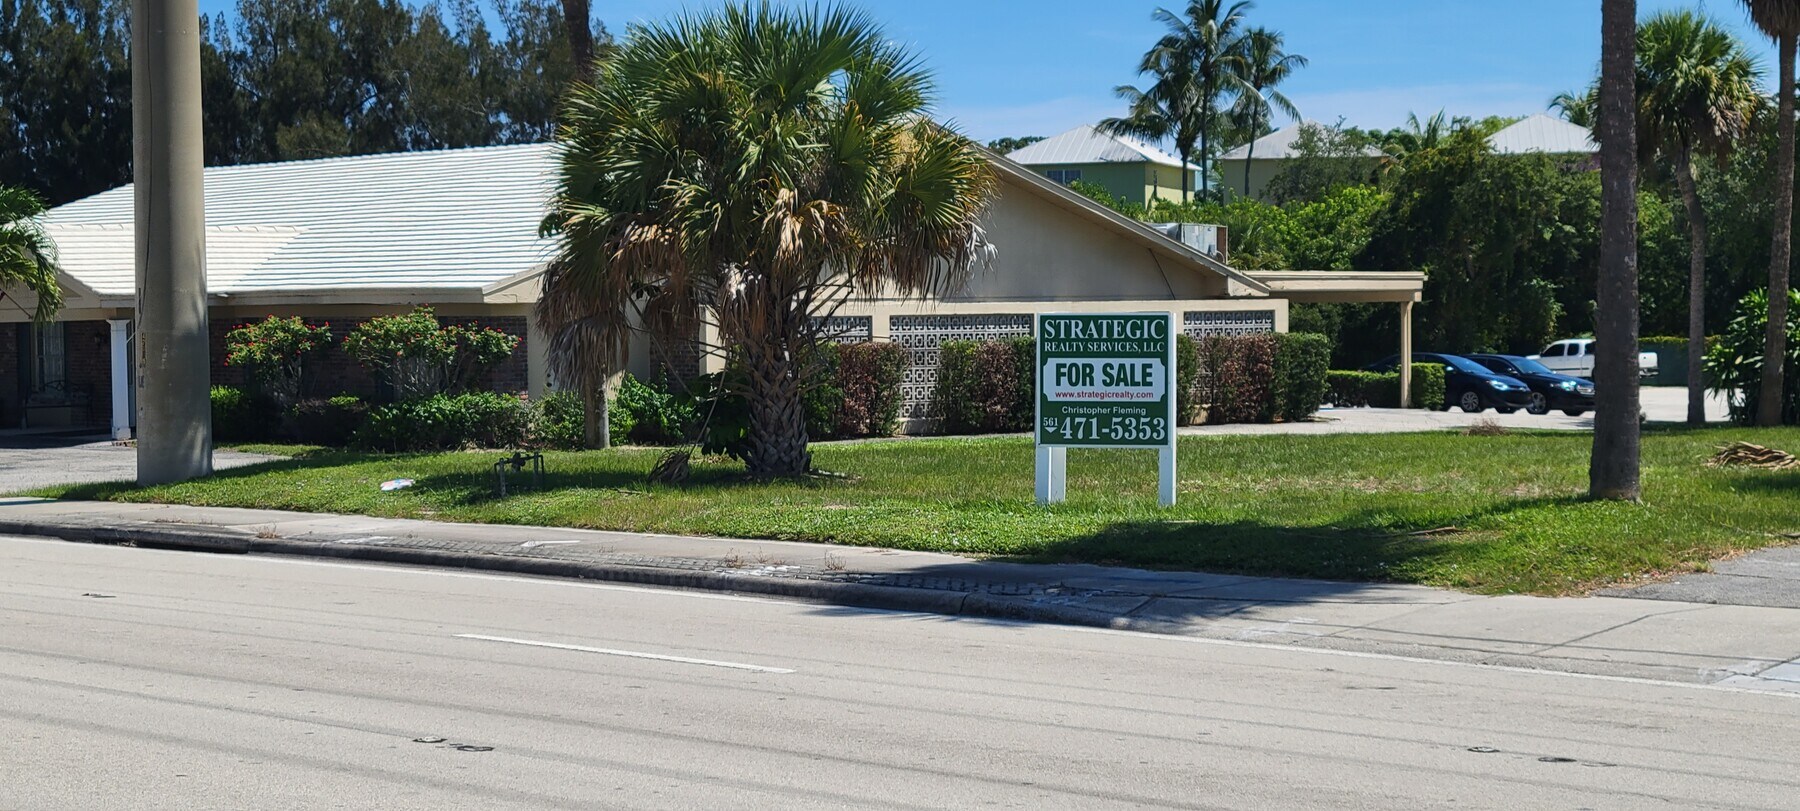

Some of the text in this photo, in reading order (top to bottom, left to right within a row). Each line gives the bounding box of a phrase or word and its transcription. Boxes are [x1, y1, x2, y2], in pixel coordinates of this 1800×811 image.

[1045, 319, 1165, 339] STRATEGIC
[1045, 342, 1165, 354] REALTY SERVICES, LLC
[1056, 363, 1153, 387] FOR SALE
[1055, 390, 1154, 400] www.strategicrealty.com
[1062, 406, 1146, 415] Christopher Fleming
[1043, 417, 1165, 440] 561 471-5353
